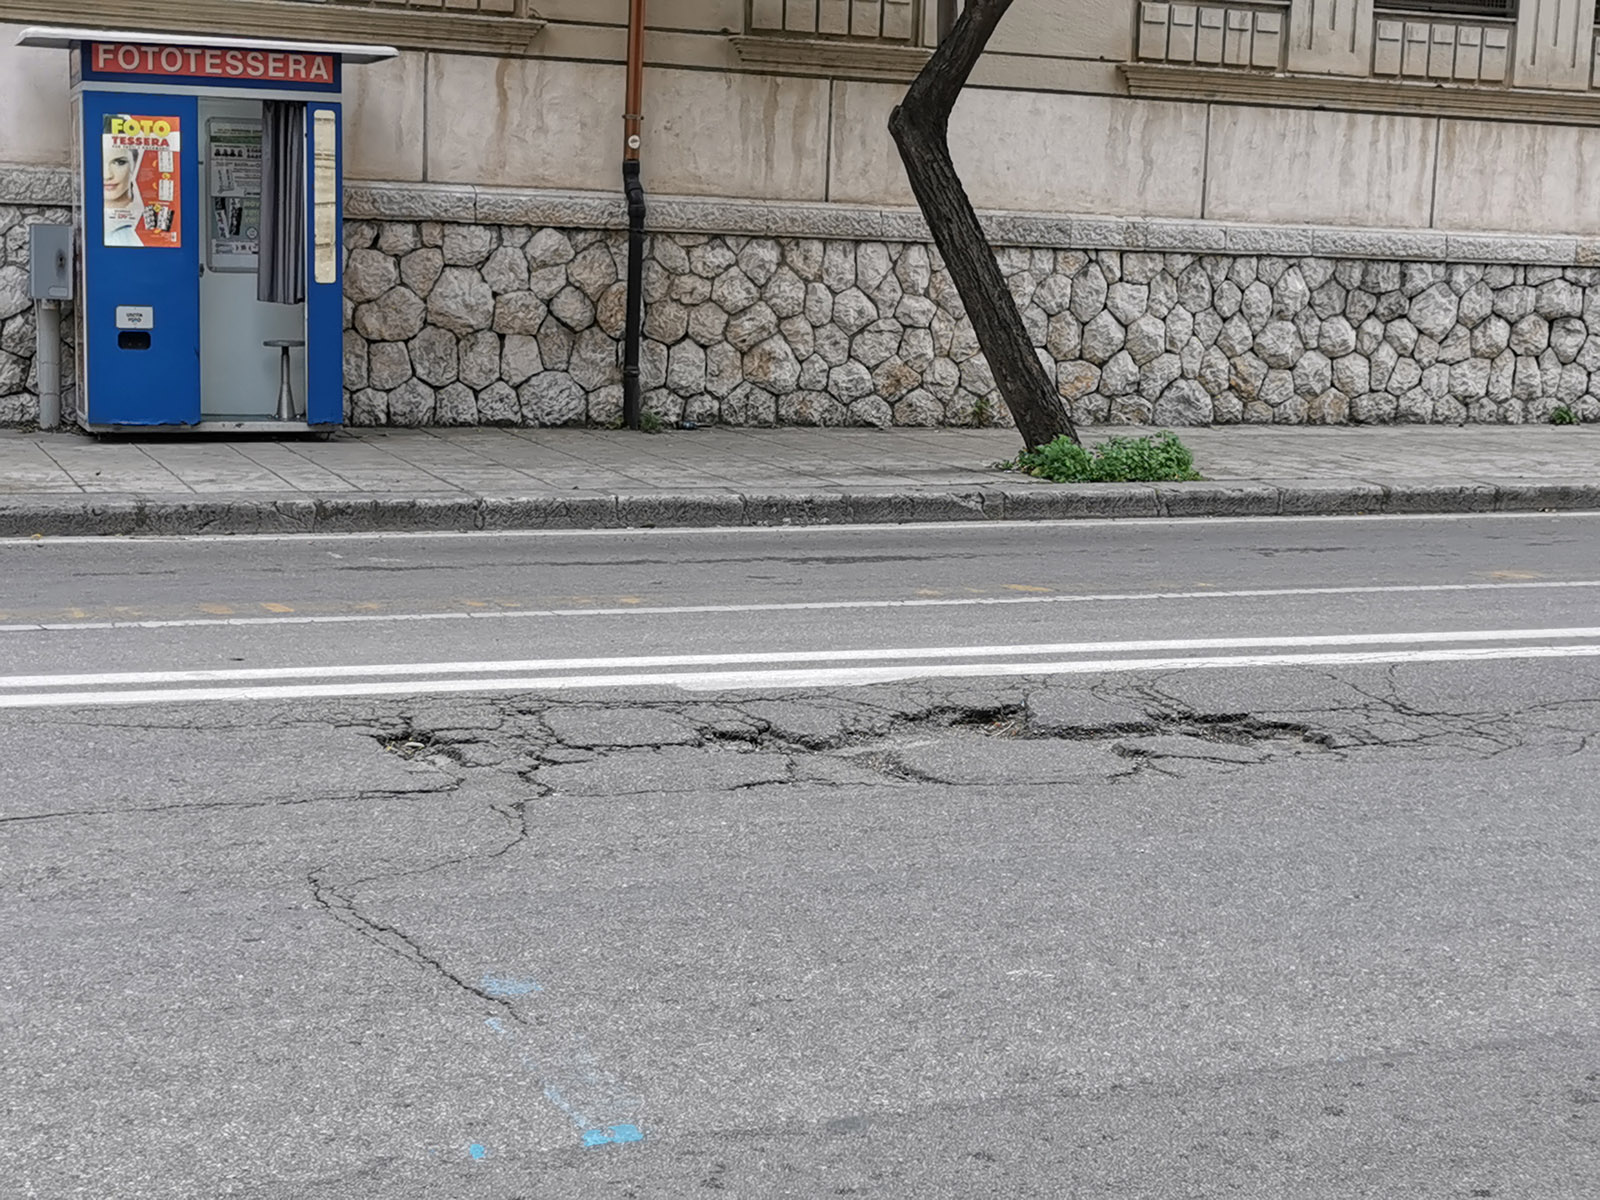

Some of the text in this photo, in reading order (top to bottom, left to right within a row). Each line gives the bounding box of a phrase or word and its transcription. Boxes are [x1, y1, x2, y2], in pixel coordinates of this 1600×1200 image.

[98, 44, 329, 80] FOTOTESSERA
[111, 118, 171, 138] FOTO
[112, 136, 170, 147] TESSERA
